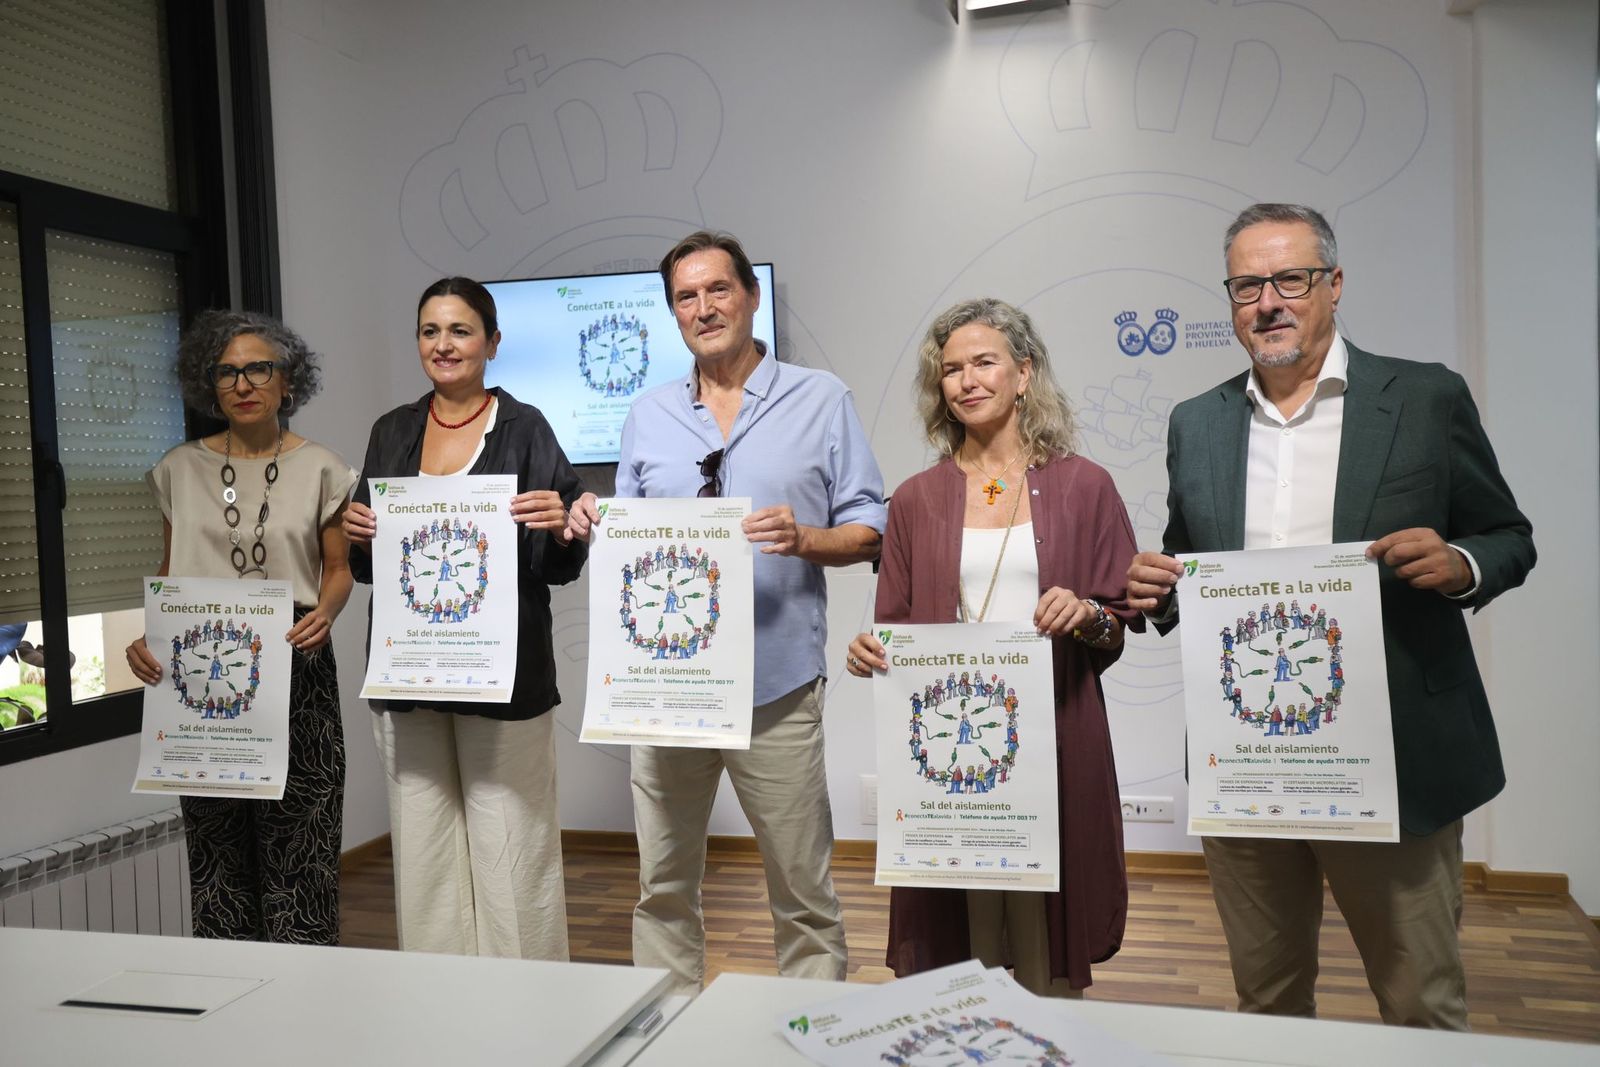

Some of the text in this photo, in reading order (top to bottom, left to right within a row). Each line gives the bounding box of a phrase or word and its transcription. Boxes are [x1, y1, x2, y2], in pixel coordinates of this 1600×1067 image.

[625, 300, 633, 308] la
[636, 299, 655, 308] vida
[1195, 339, 1231, 348] HUELVA
[388, 503, 447, 514] ConéctaTE
[460, 502, 470, 513] la
[474, 502, 497, 512] vida
[607, 527, 730, 539] ConéctaTE a la vida
[1200, 579, 1352, 599] ConéctaTE a la vida
[160, 602, 221, 614] ConéctaTE
[235, 605, 246, 614] la
[250, 605, 274, 615] vida
[434, 630, 479, 638] aislamiento
[892, 652, 1028, 666] ConéctaTE a la vida
[628, 666, 710, 676] Sal del aislamiento
[207, 725, 252, 734] aislamiento
[1236, 744, 1339, 754] Sal del aislamiento
[920, 801, 1011, 811] Sal del aislamiento
[920, 1012, 931, 1021] a
[931, 1004, 950, 1018] la
[952, 995, 987, 1010] vida
